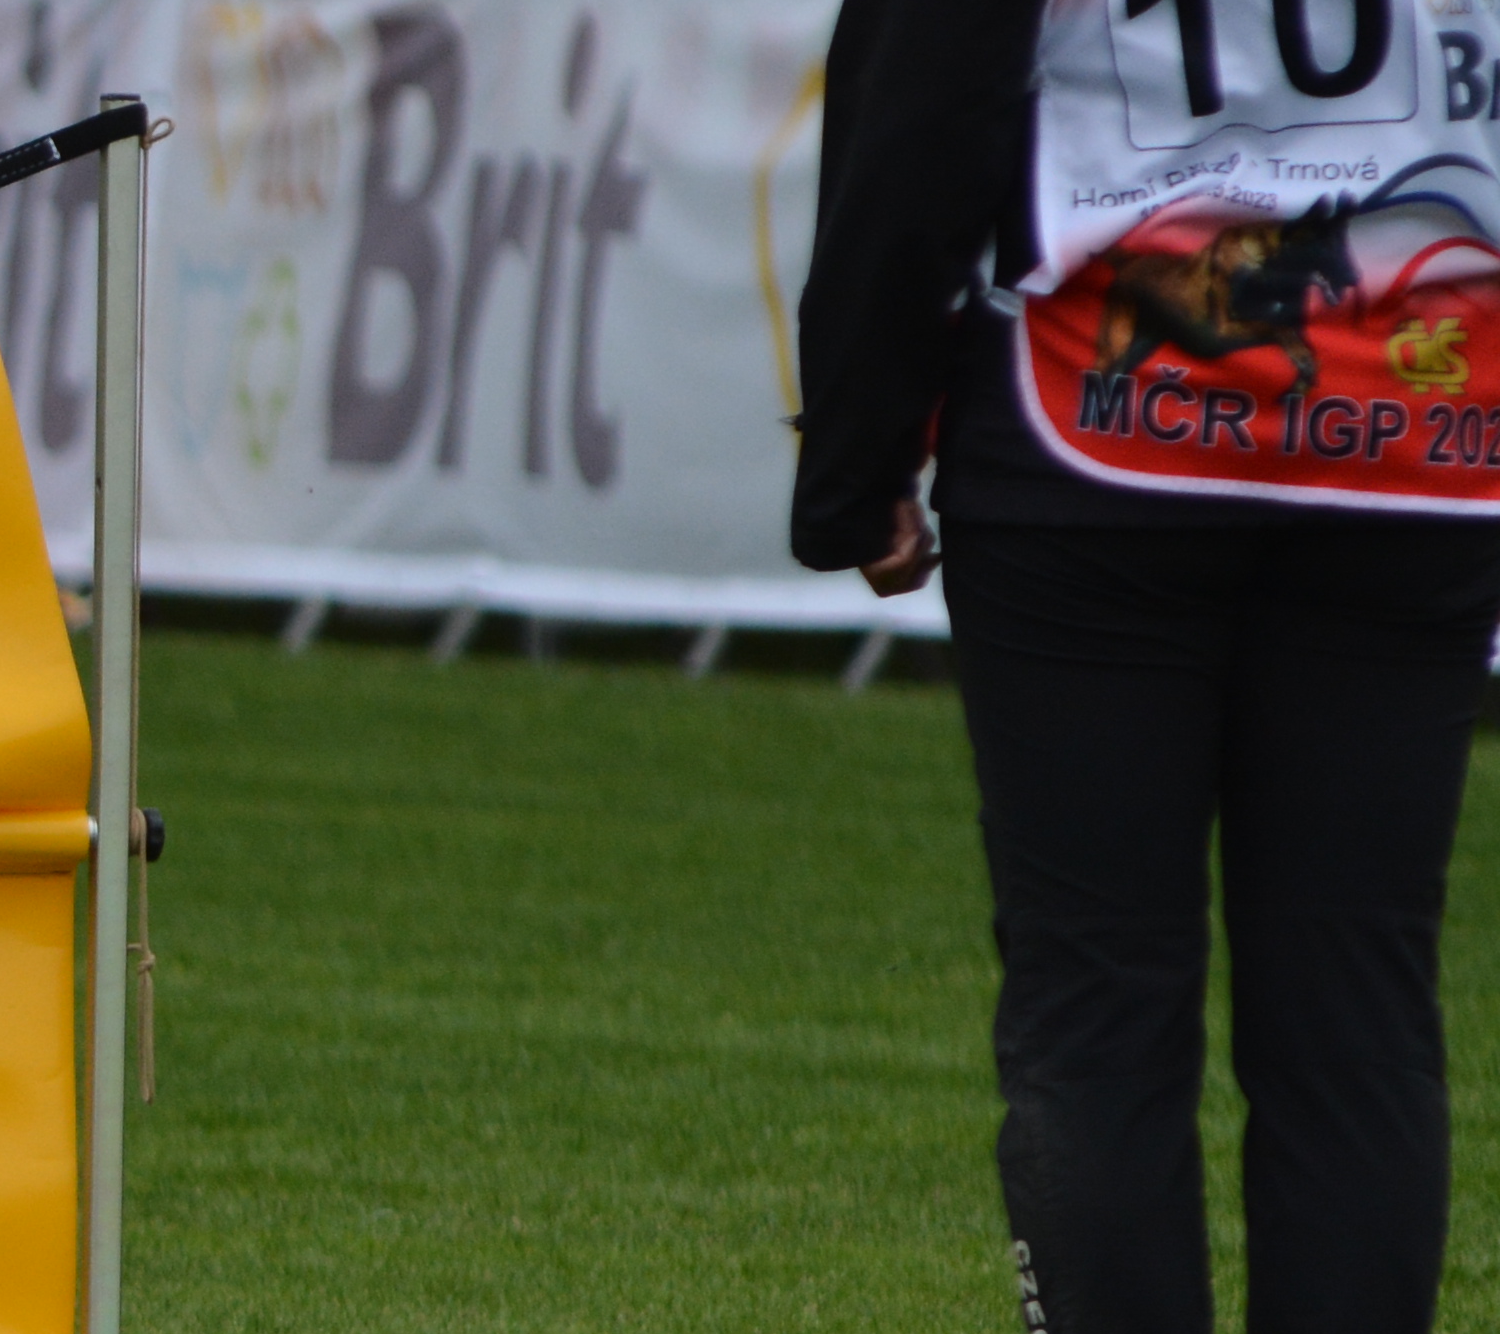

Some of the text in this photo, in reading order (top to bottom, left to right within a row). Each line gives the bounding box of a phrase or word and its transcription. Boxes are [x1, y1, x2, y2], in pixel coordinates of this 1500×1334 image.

[1266, 155, 1380, 181] Trnová
[327, 4, 648, 489] Brit
[1078, 364, 1259, 452] MČR
[1281, 392, 1410, 461] IGP
